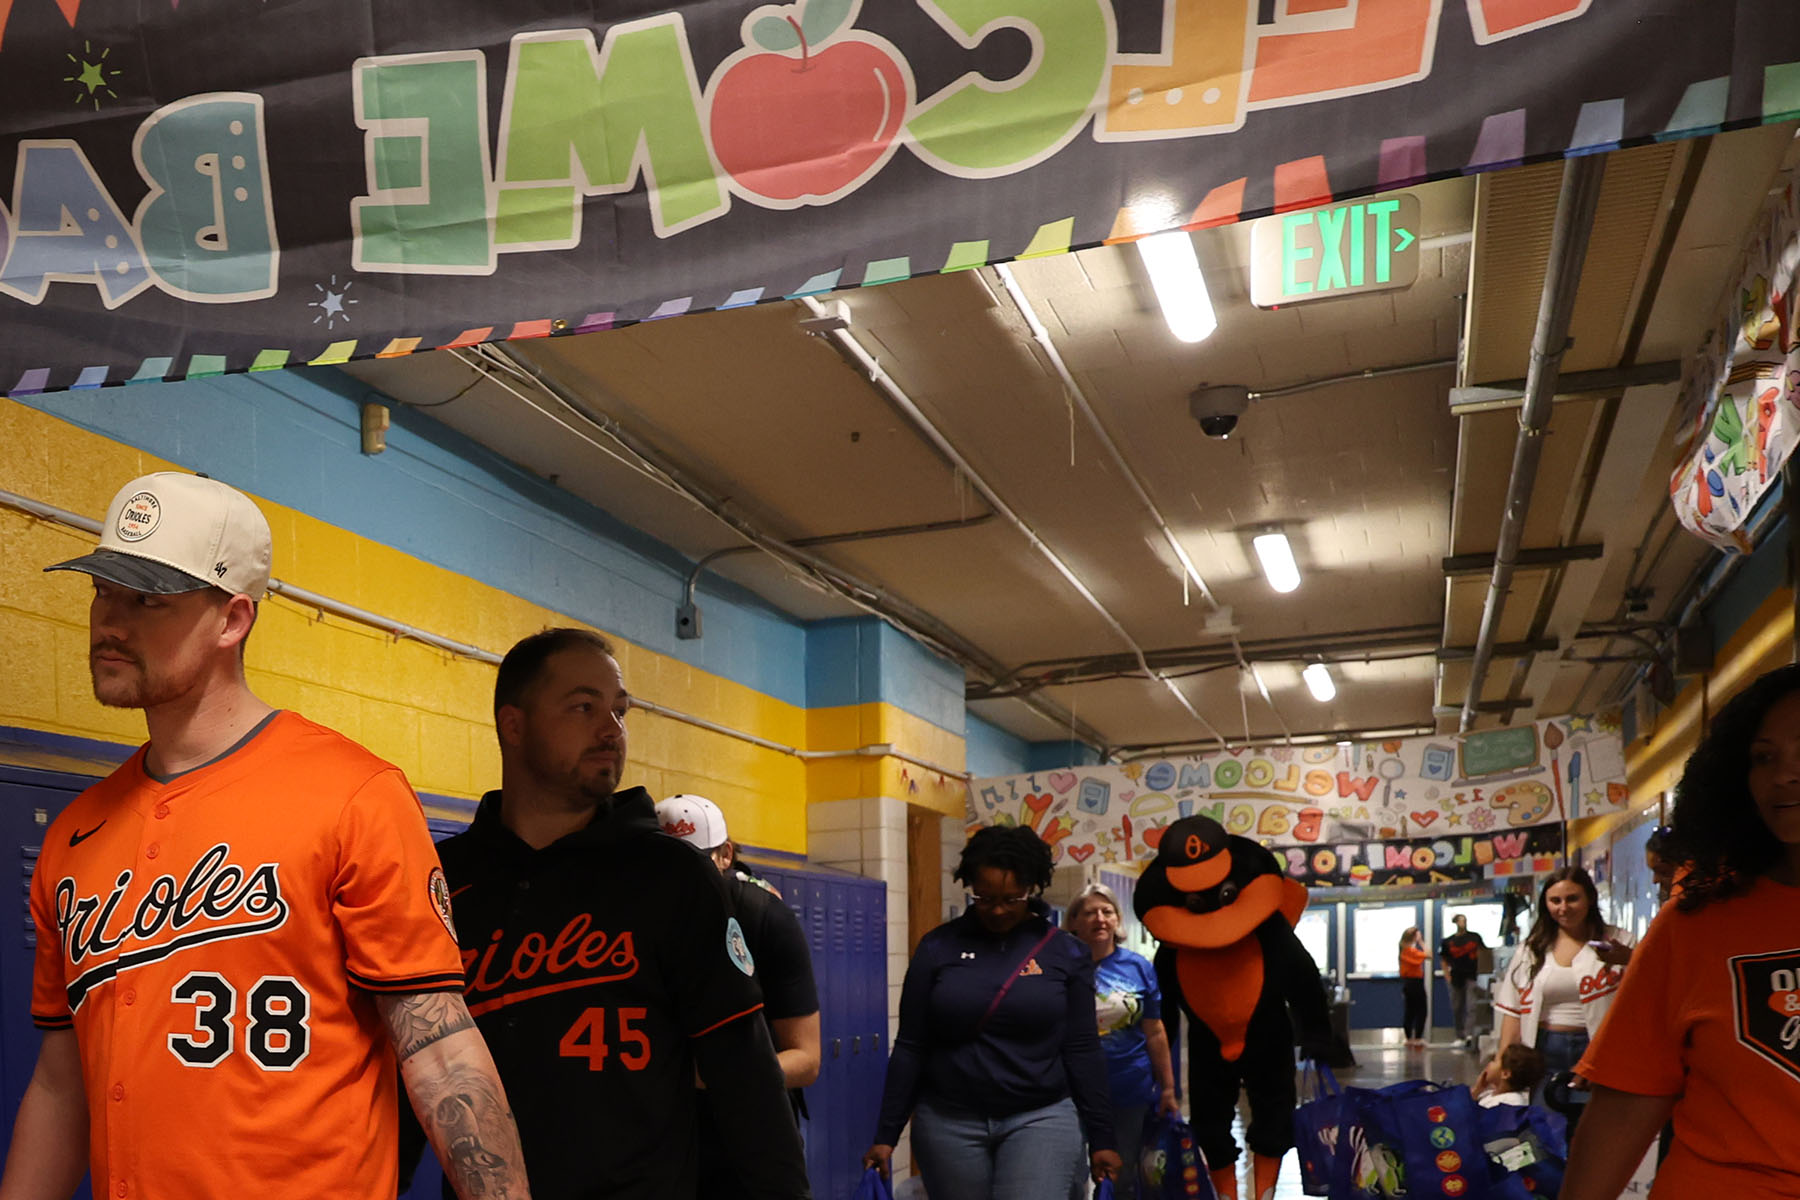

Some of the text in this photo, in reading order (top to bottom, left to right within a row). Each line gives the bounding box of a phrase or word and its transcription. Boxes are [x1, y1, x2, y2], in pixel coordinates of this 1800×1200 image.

[1282, 199, 1400, 297] EXIT
[125, 508, 151, 524] ORIOLES
[462, 913, 639, 1005] rioles
[167, 970, 311, 1071] 38
[559, 1007, 651, 1072] 45
